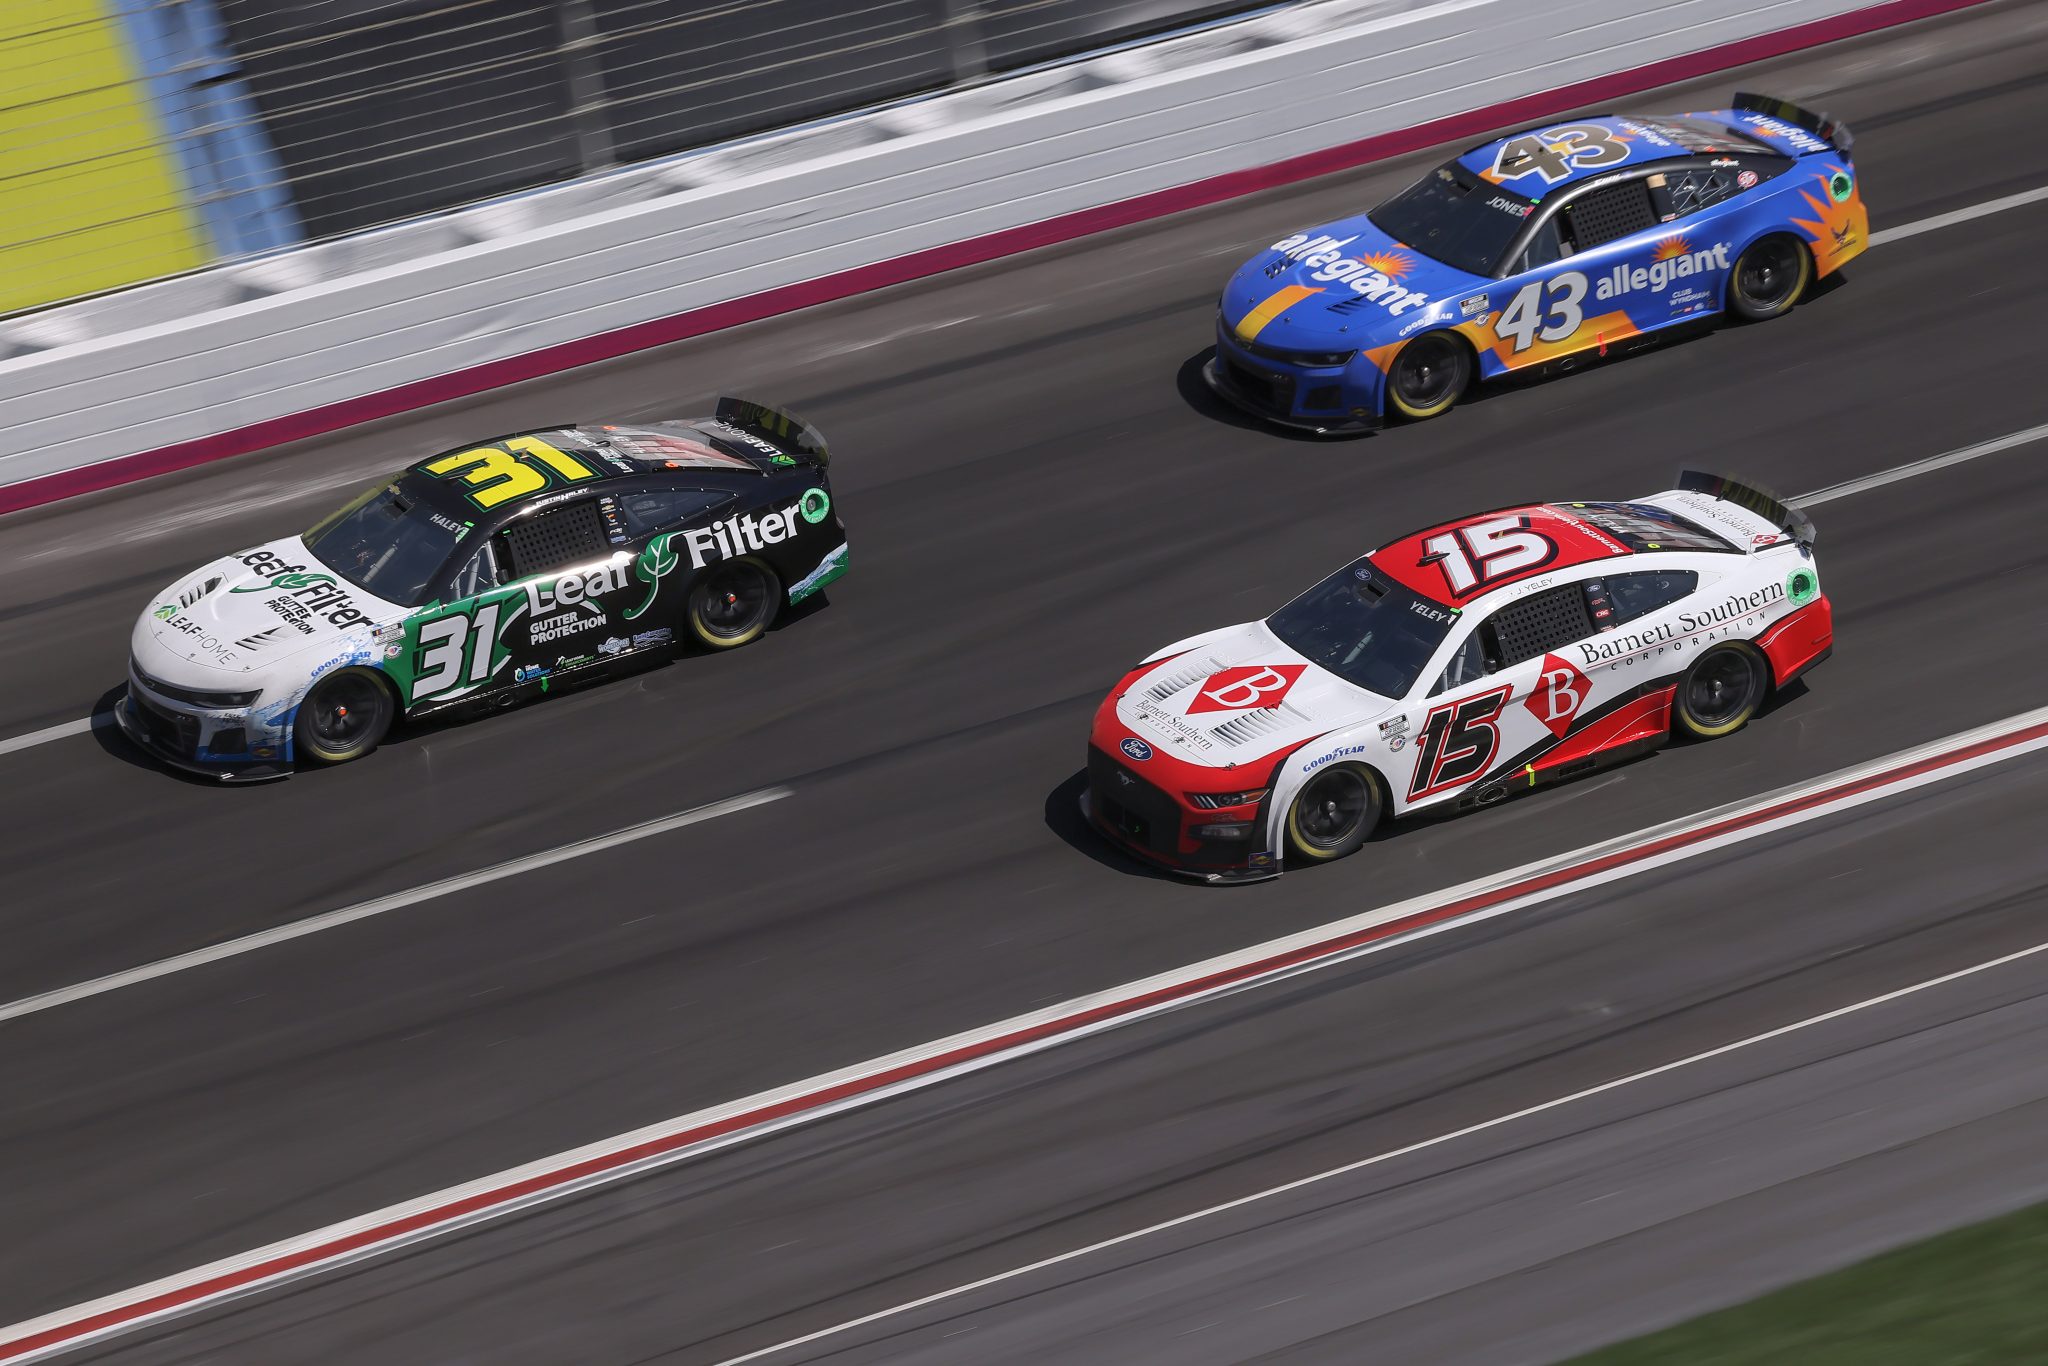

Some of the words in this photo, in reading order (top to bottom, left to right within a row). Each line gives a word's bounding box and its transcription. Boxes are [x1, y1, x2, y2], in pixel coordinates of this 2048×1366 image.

[1491, 124, 1631, 184] 43
[1486, 195, 1525, 217] JONES
[1270, 233, 1429, 316] allegiant
[1596, 242, 1731, 301] allegiant
[1399, 313, 1454, 337] GOODAR
[1494, 271, 1588, 354] 43
[425, 436, 595, 508] 31
[429, 513, 464, 534] HALEY
[236, 551, 307, 578] eaf
[526, 550, 634, 618] Leaf
[682, 504, 801, 569] Filter
[1424, 512, 1552, 596] 15
[1410, 600, 1447, 622] YELEY
[1524, 577, 1553, 592] YELEY
[530, 611, 578, 634] GUTTER
[531, 614, 607, 645] PROTECTION
[1577, 622, 1674, 664] Barnett
[1679, 582, 1784, 632] Southern
[1611, 611, 1766, 671] CORPORATION
[410, 602, 501, 704] 31
[1202, 666, 1287, 707] B
[1542, 668, 1580, 722] B
[1122, 738, 1151, 759] Ford
[1136, 699, 1172, 722] Barnett
[1168, 714, 1214, 751] Southern
[1406, 683, 1514, 804] 15
[1302, 745, 1366, 773] GOODYEAR
